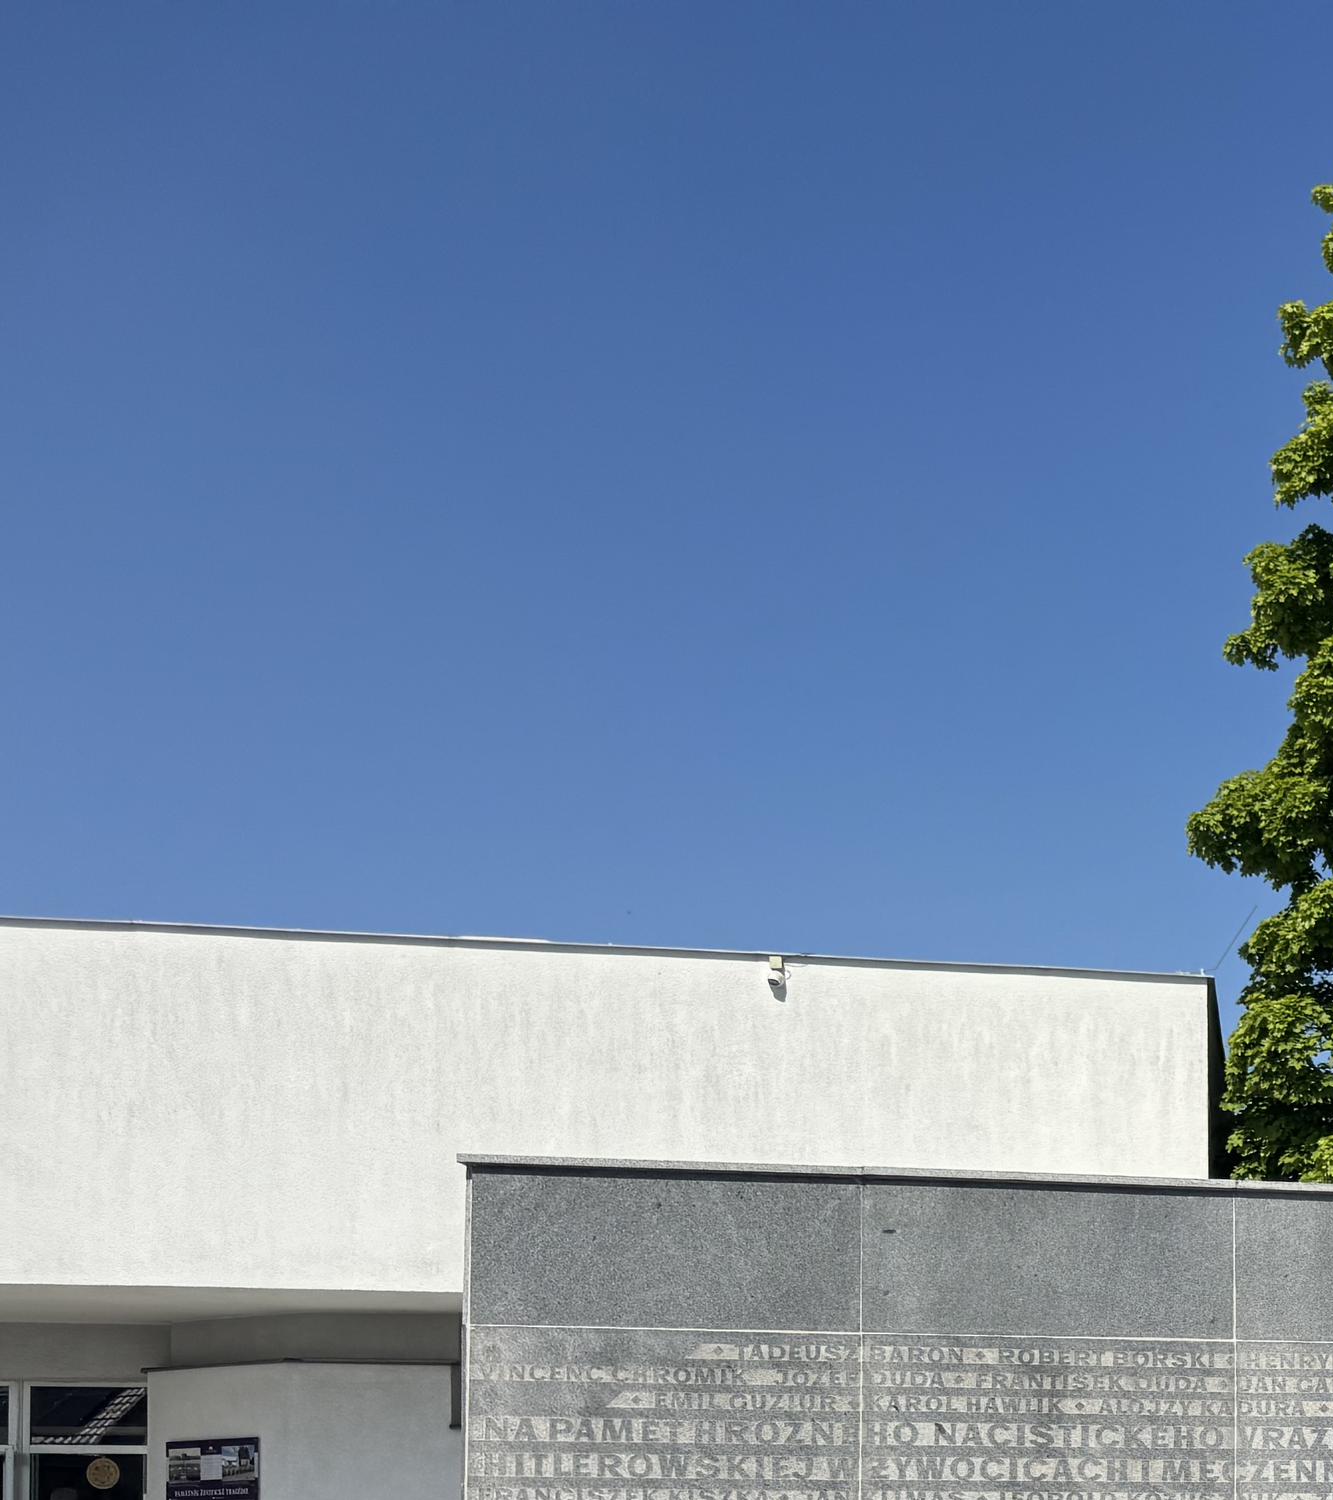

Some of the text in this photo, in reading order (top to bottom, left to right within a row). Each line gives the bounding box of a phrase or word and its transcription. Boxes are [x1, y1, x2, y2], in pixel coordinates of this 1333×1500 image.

[737, 1344, 859, 1363] TADEUSZ
[870, 1347, 963, 1364] BARON
[998, 1349, 1104, 1367] ROBERT
[1112, 1351, 1214, 1368] BORSKI
[611, 1366, 746, 1385] CHROMIK
[775, 1369, 859, 1387] JOZEF
[870, 1370, 945, 1388] DUDA
[976, 1372, 1123, 1391] FRANTISEK
[1243, 1376, 1286, 1393] JAN
[654, 1392, 715, 1410] EMIL
[728, 1393, 836, 1411] GUZIUR
[868, 1395, 957, 1413] KAROL
[966, 1396, 1062, 1414] HAWLIK
[1098, 1398, 1188, 1415] ALOJZY
[1201, 1399, 1303, 1417] KADURA
[484, 1417, 536, 1443] NA
[483, 1453, 813, 1480] HITLEROWSKIEJ
[826, 1456, 853, 1480] W
[1141, 1458, 1149, 1482] I
